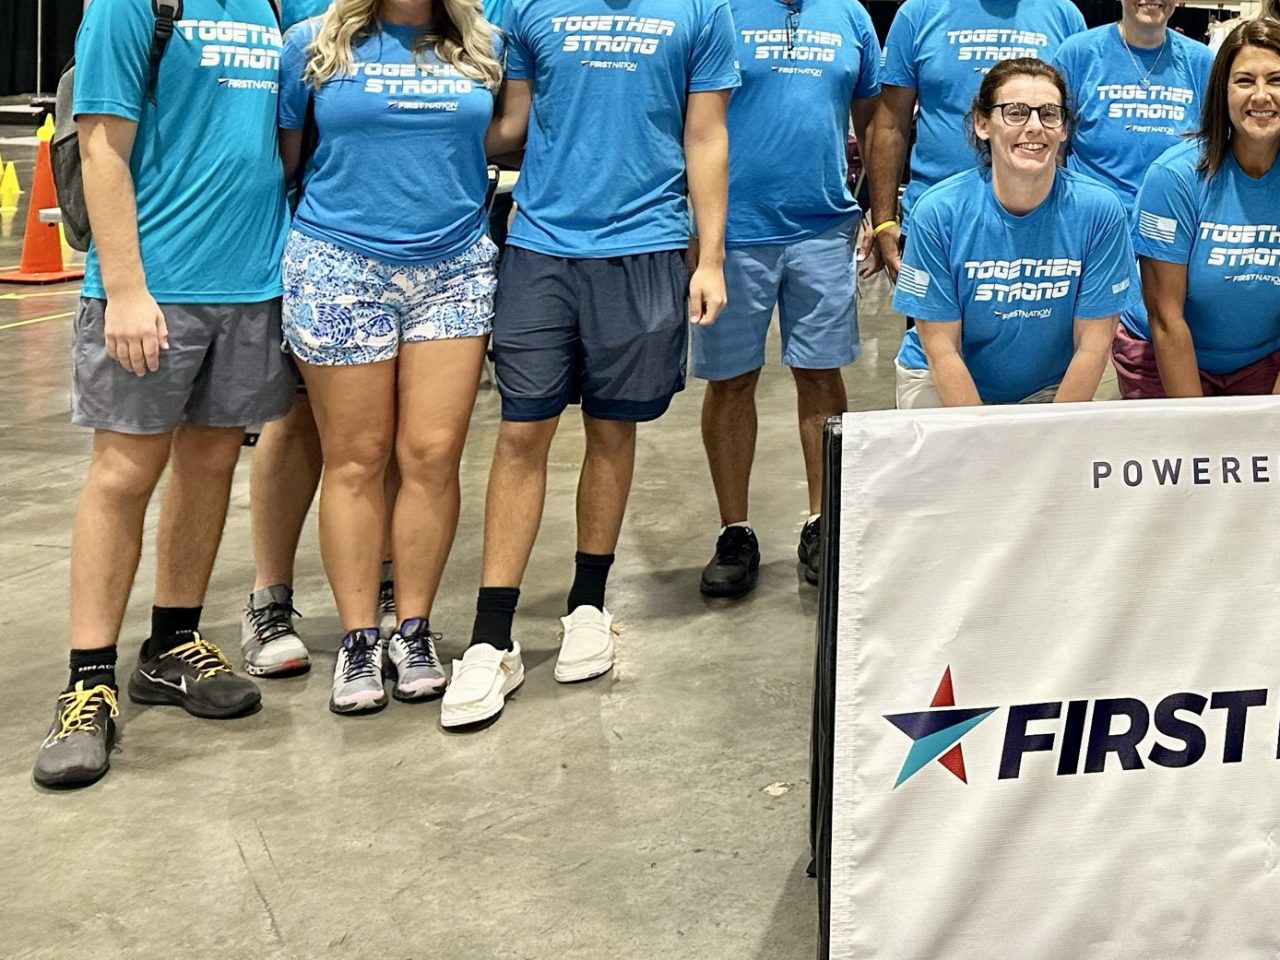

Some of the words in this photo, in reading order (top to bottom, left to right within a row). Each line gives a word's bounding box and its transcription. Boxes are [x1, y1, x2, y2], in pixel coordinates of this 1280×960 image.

[177, 20, 283, 48] TOGETH
[552, 15, 676, 36] TOGETHER
[562, 35, 659, 55] STRONG
[946, 29, 1048, 47] TOGETHER
[200, 44, 280, 70] STRON
[754, 46, 836, 62] STRONG
[958, 46, 1038, 60] STRONG
[351, 62, 466, 78] TOGETHE
[364, 79, 473, 94] STRONG
[1097, 84, 1194, 104] TOGETHER
[1108, 103, 1185, 120] STRONG
[964, 258, 1082, 280] TOGETHER
[974, 280, 1070, 304] STRONG
[998, 688, 1269, 781] FIRST
